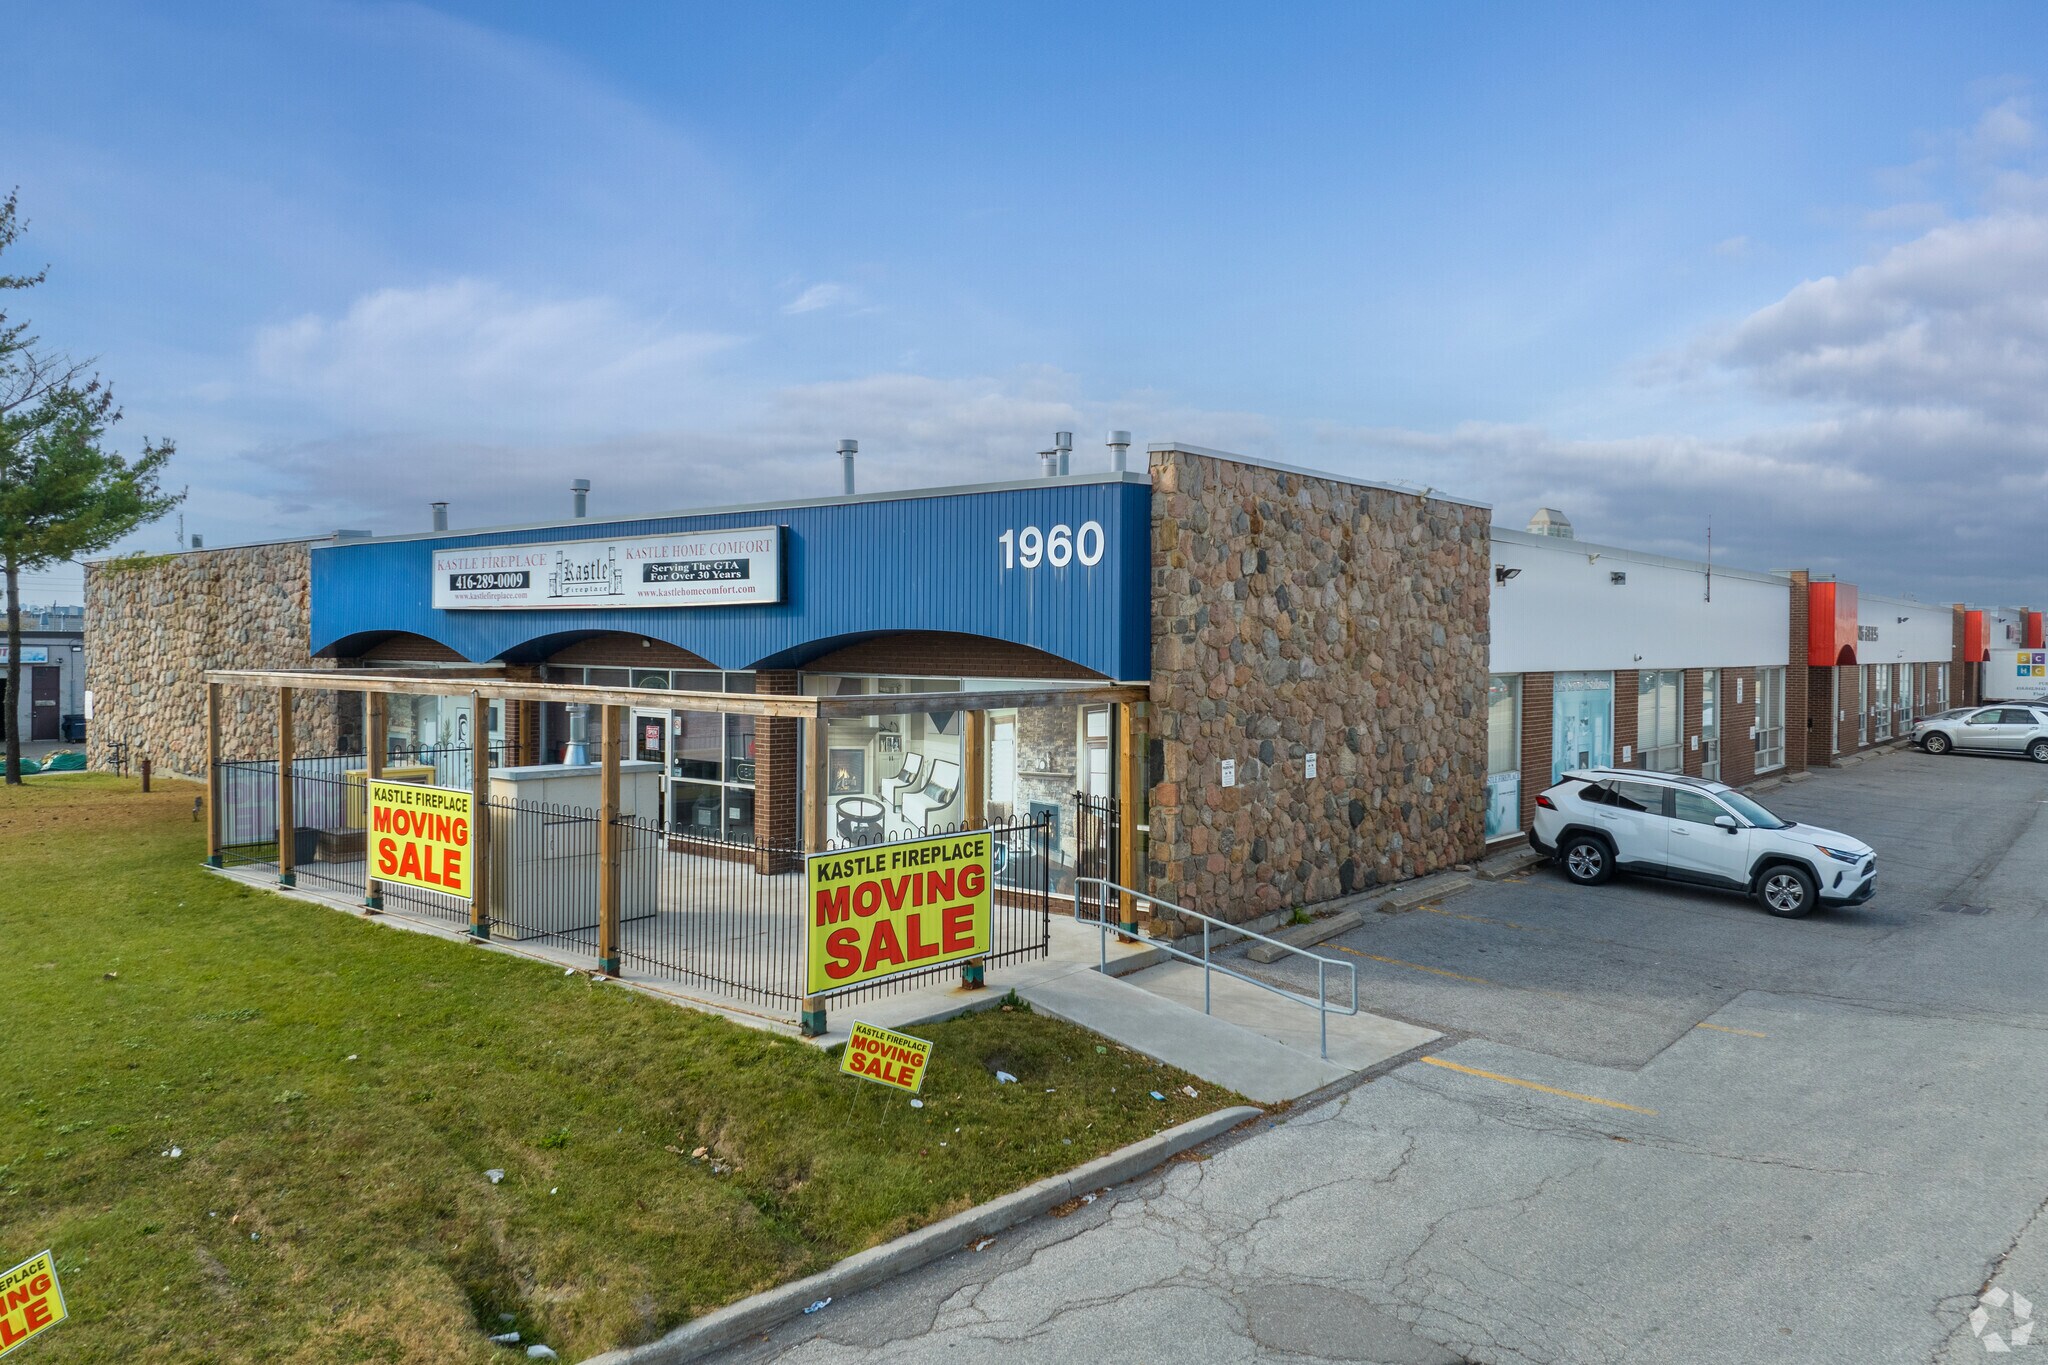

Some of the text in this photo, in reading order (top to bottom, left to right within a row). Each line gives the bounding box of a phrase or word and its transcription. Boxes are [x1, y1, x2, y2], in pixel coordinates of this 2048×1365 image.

[626, 539, 773, 560] KASTLE HOME COMFORT
[999, 521, 1105, 569] 1960
[437, 553, 547, 571] KASTLE FIREPLACE
[563, 558, 608, 582] Kastle
[651, 561, 739, 573] Serving The GTA
[455, 573, 523, 590] 416-289-0009
[650, 573, 669, 581] For
[671, 572, 696, 580] Over
[697, 571, 710, 579] 30
[454, 591, 528, 601] www.kastlefireplace.com
[563, 586, 608, 594] Fireplace
[637, 585, 756, 597] www.kastlehomecomfort.com
[374, 788, 467, 813] KASTLE FIREPLACE
[373, 805, 468, 847] MOVING
[378, 837, 462, 890] SALE
[818, 854, 886, 882] KASTLE
[892, 840, 984, 870] FIREPLACE
[816, 864, 985, 927] MOVING
[824, 903, 975, 980] SALE
[851, 1034, 924, 1067] MOVING
[856, 1025, 928, 1052] KASTLE FIREPLACE
[850, 1052, 915, 1087] SALE
[0, 1296, 53, 1351] LE
